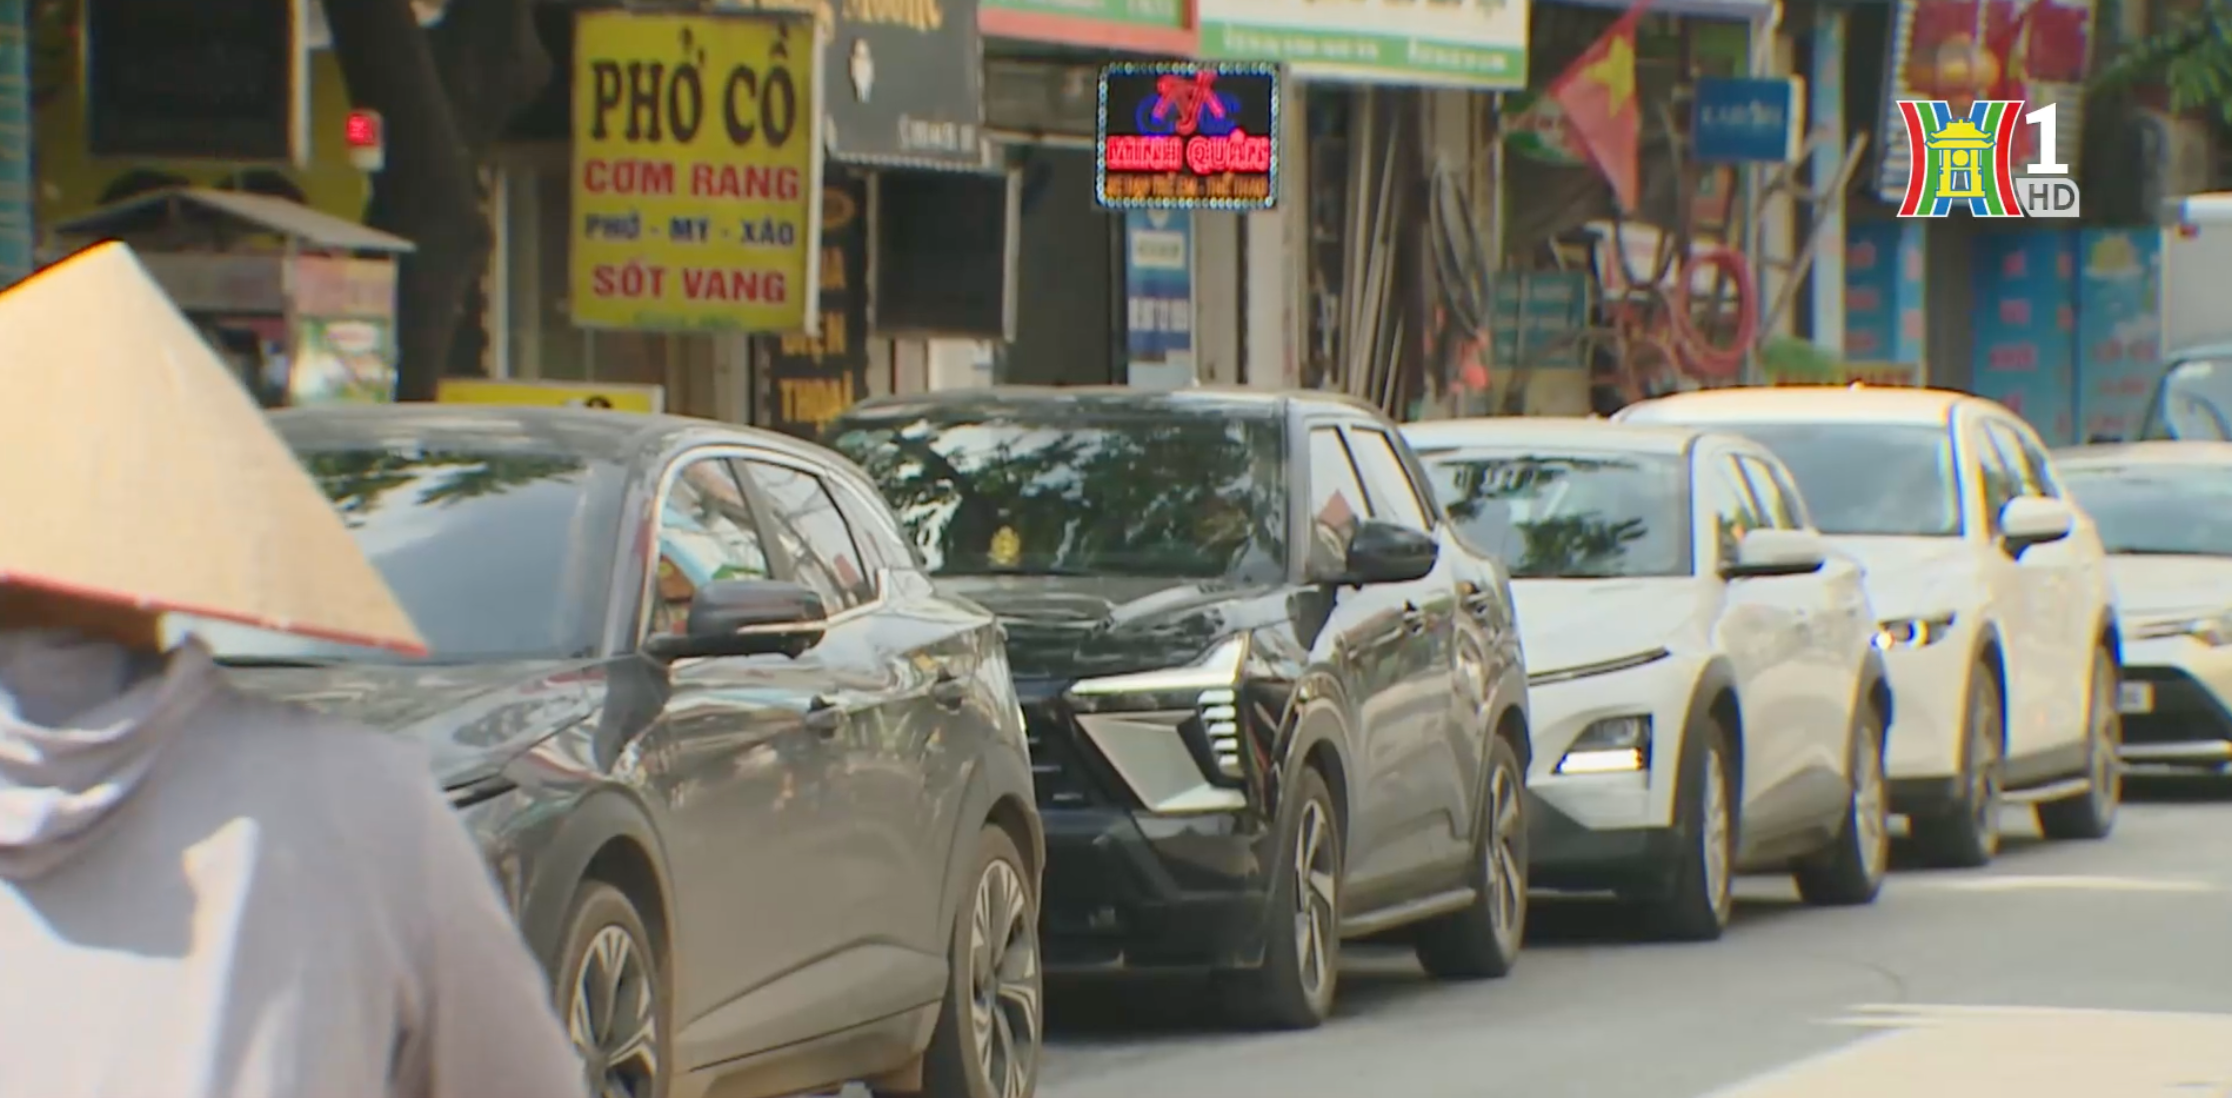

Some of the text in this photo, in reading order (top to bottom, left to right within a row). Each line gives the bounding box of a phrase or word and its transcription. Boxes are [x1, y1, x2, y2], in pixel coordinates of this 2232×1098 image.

[591, 22, 796, 147] PHỞ CỔ
[584, 158, 798, 200] CƠM RANG
[683, 267, 786, 304] VANG
